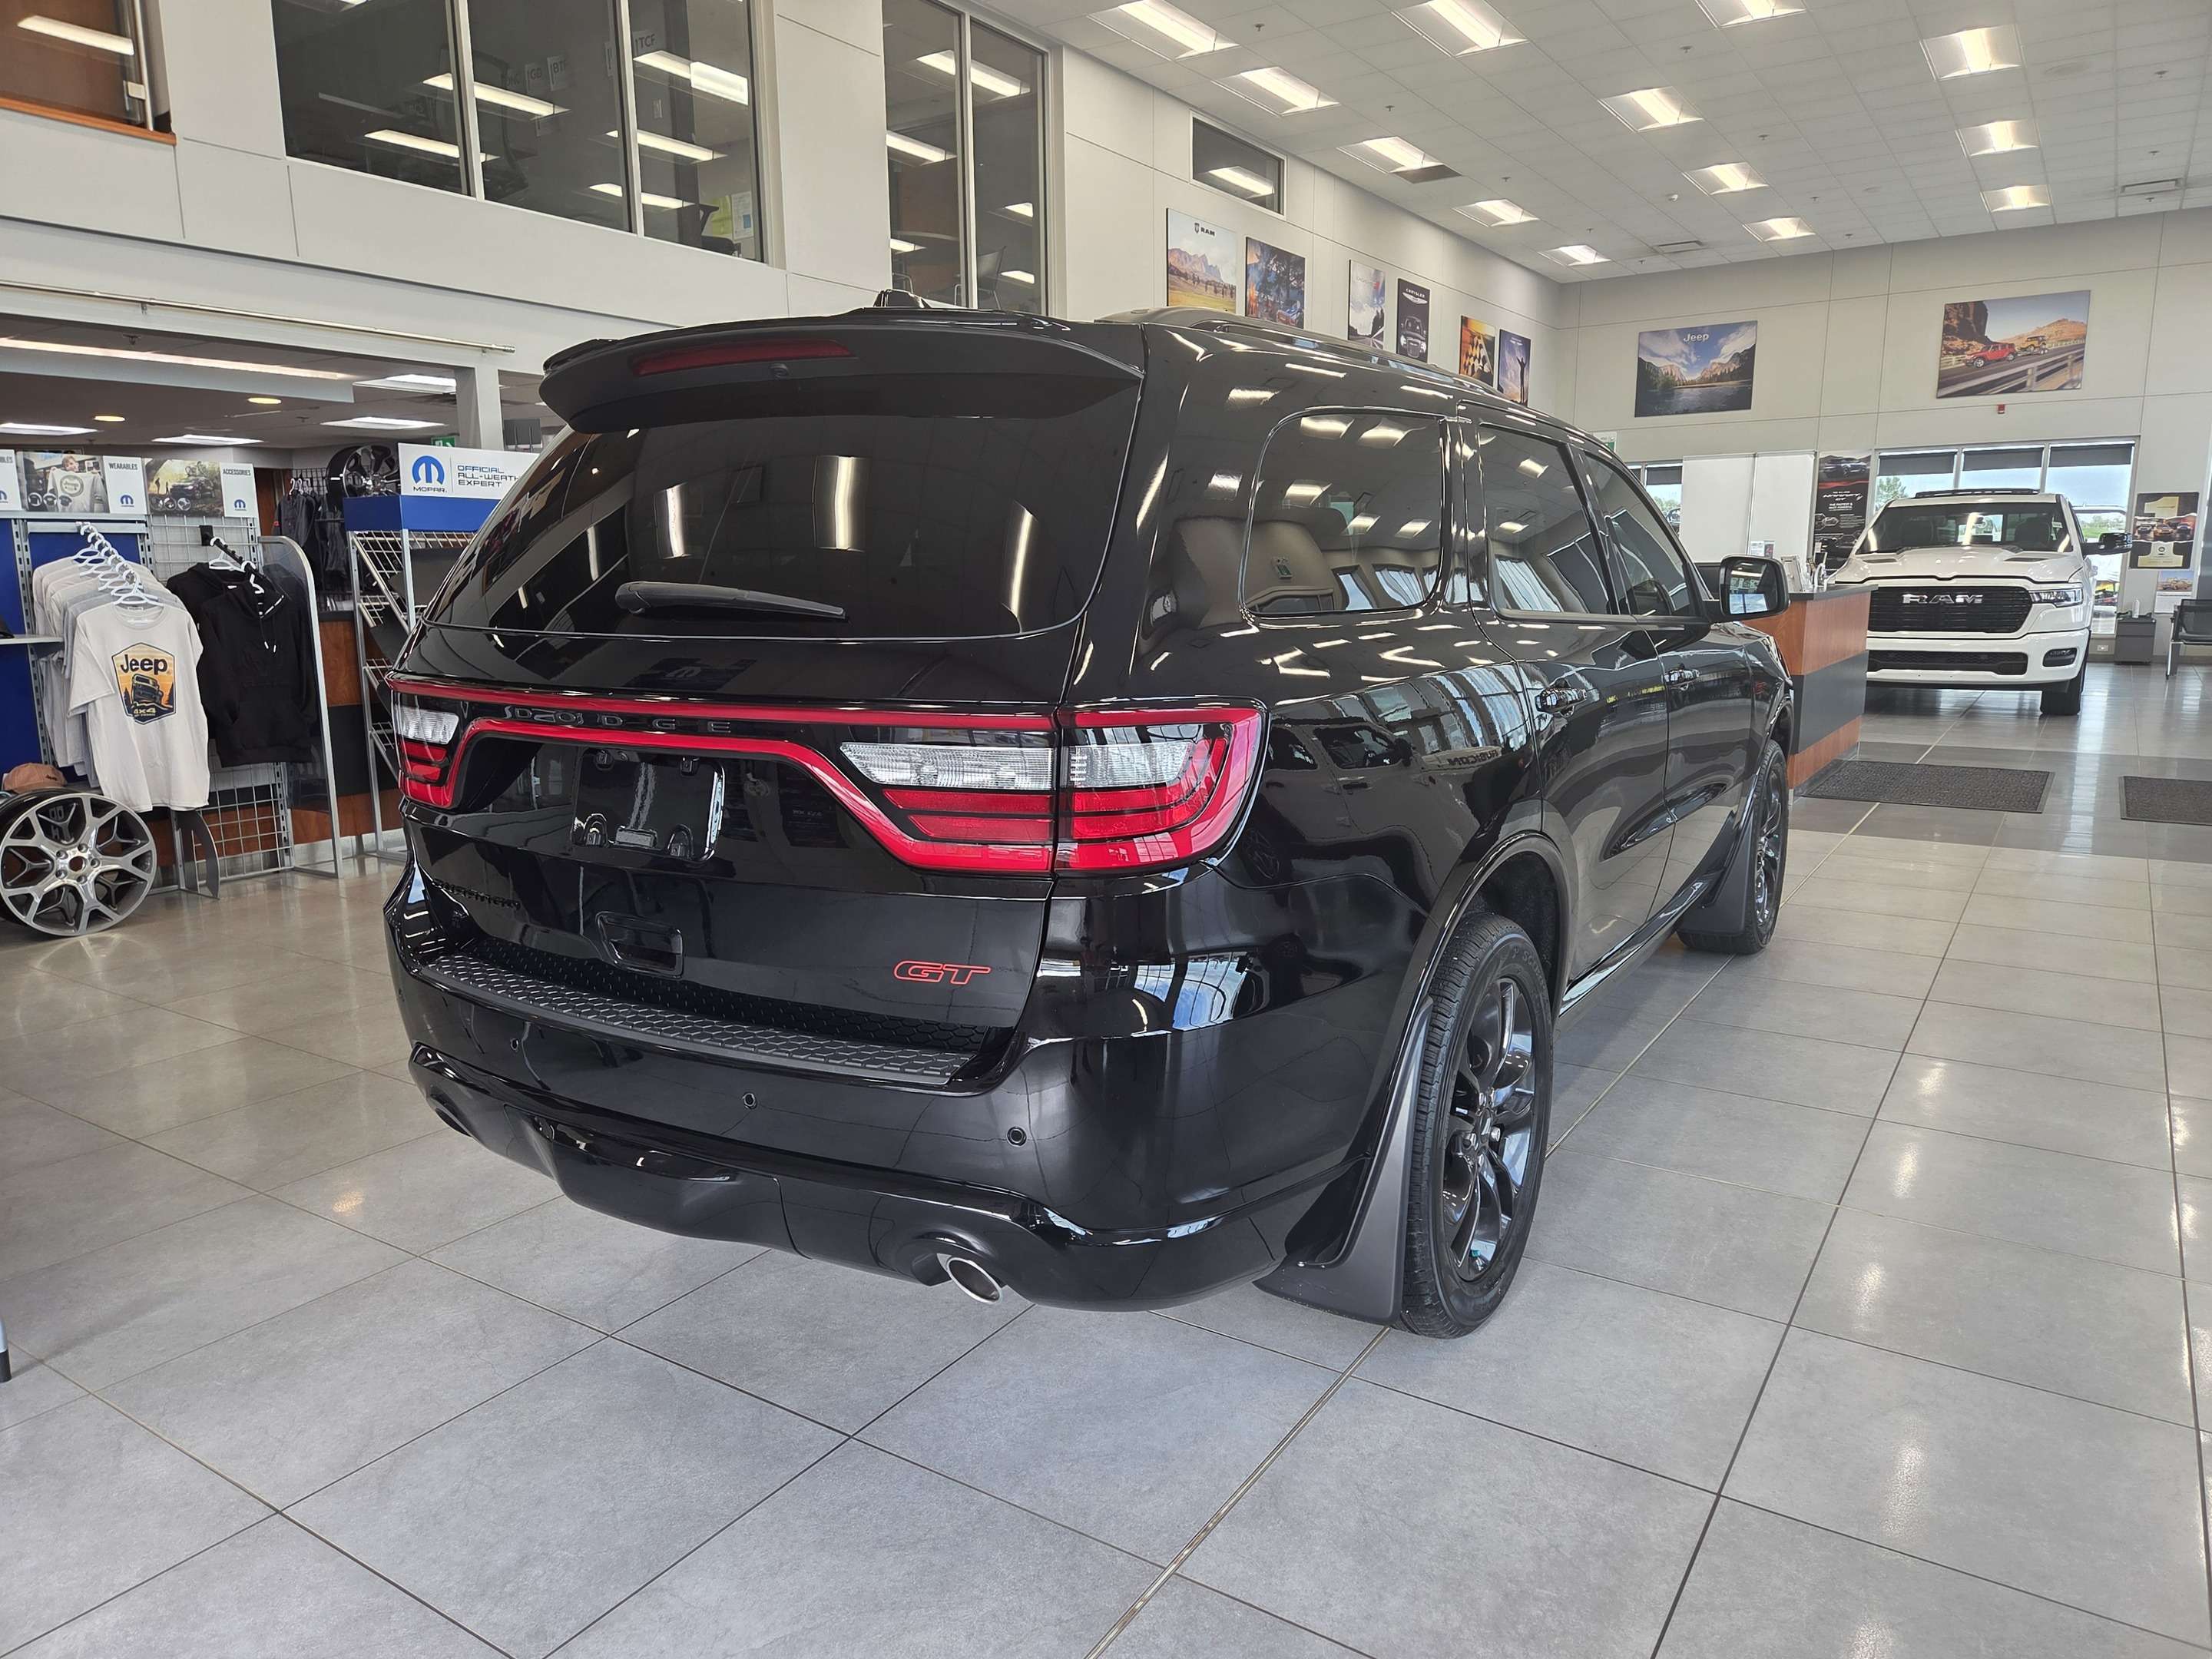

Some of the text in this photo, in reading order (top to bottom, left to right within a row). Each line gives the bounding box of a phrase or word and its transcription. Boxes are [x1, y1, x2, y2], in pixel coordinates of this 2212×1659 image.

[1200, 227, 1216, 237] RAM
[1683, 333, 1710, 343] Jeep
[108, 462, 139, 471] WEARABLES
[457, 465, 505, 474] OFFICIAL
[222, 468, 252, 476] ACCESSORIES
[457, 472, 520, 482] ALL-WEATH
[458, 479, 502, 488] EXPERT
[1902, 593, 1984, 604] RAM
[120, 654, 168, 675] Jeep
[515, 707, 731, 733] DODGE
[892, 959, 992, 985] GT
